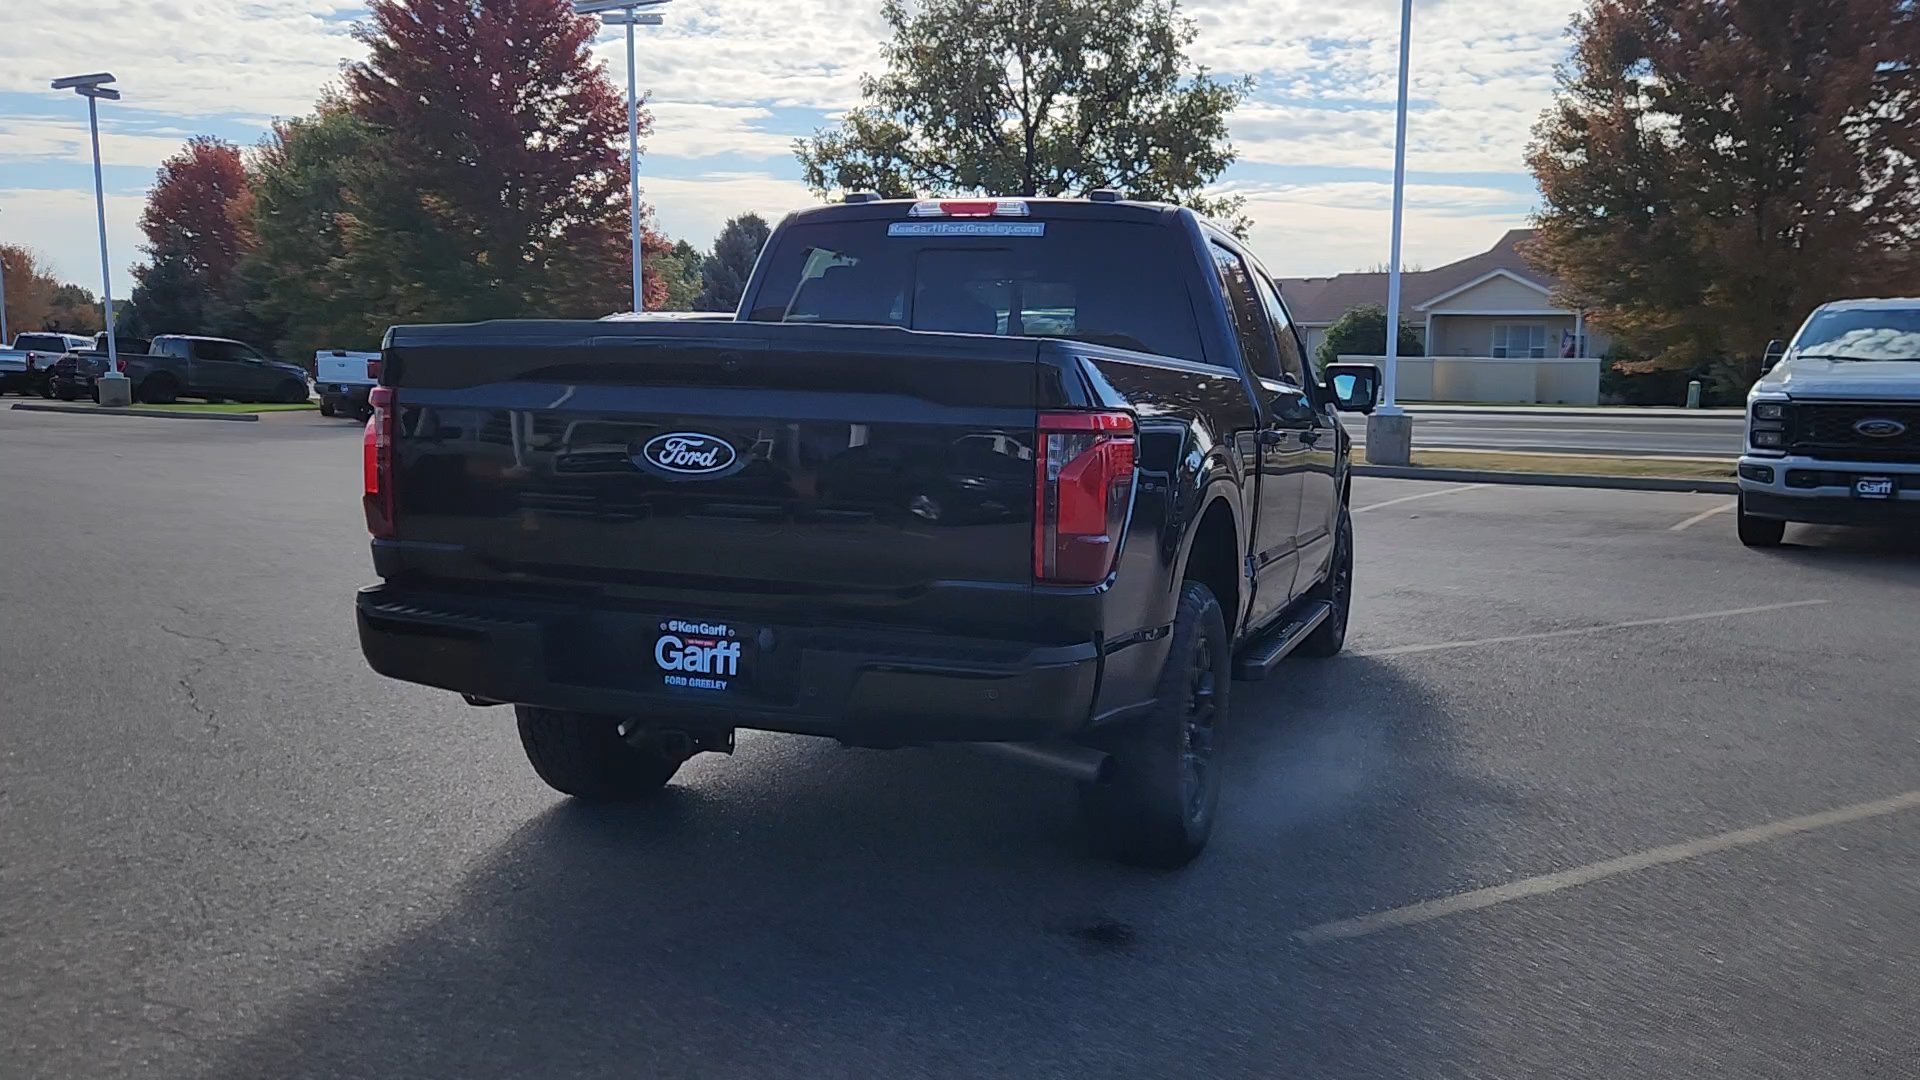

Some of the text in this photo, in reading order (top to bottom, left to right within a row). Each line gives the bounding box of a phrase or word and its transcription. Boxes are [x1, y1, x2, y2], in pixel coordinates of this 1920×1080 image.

[659, 437, 719, 467] Ford
[1857, 481, 1893, 494] Garff
[678, 621, 726, 636] Ken Garff
[655, 635, 740, 675] Garff
[664, 675, 727, 690] FORD GREELEY
